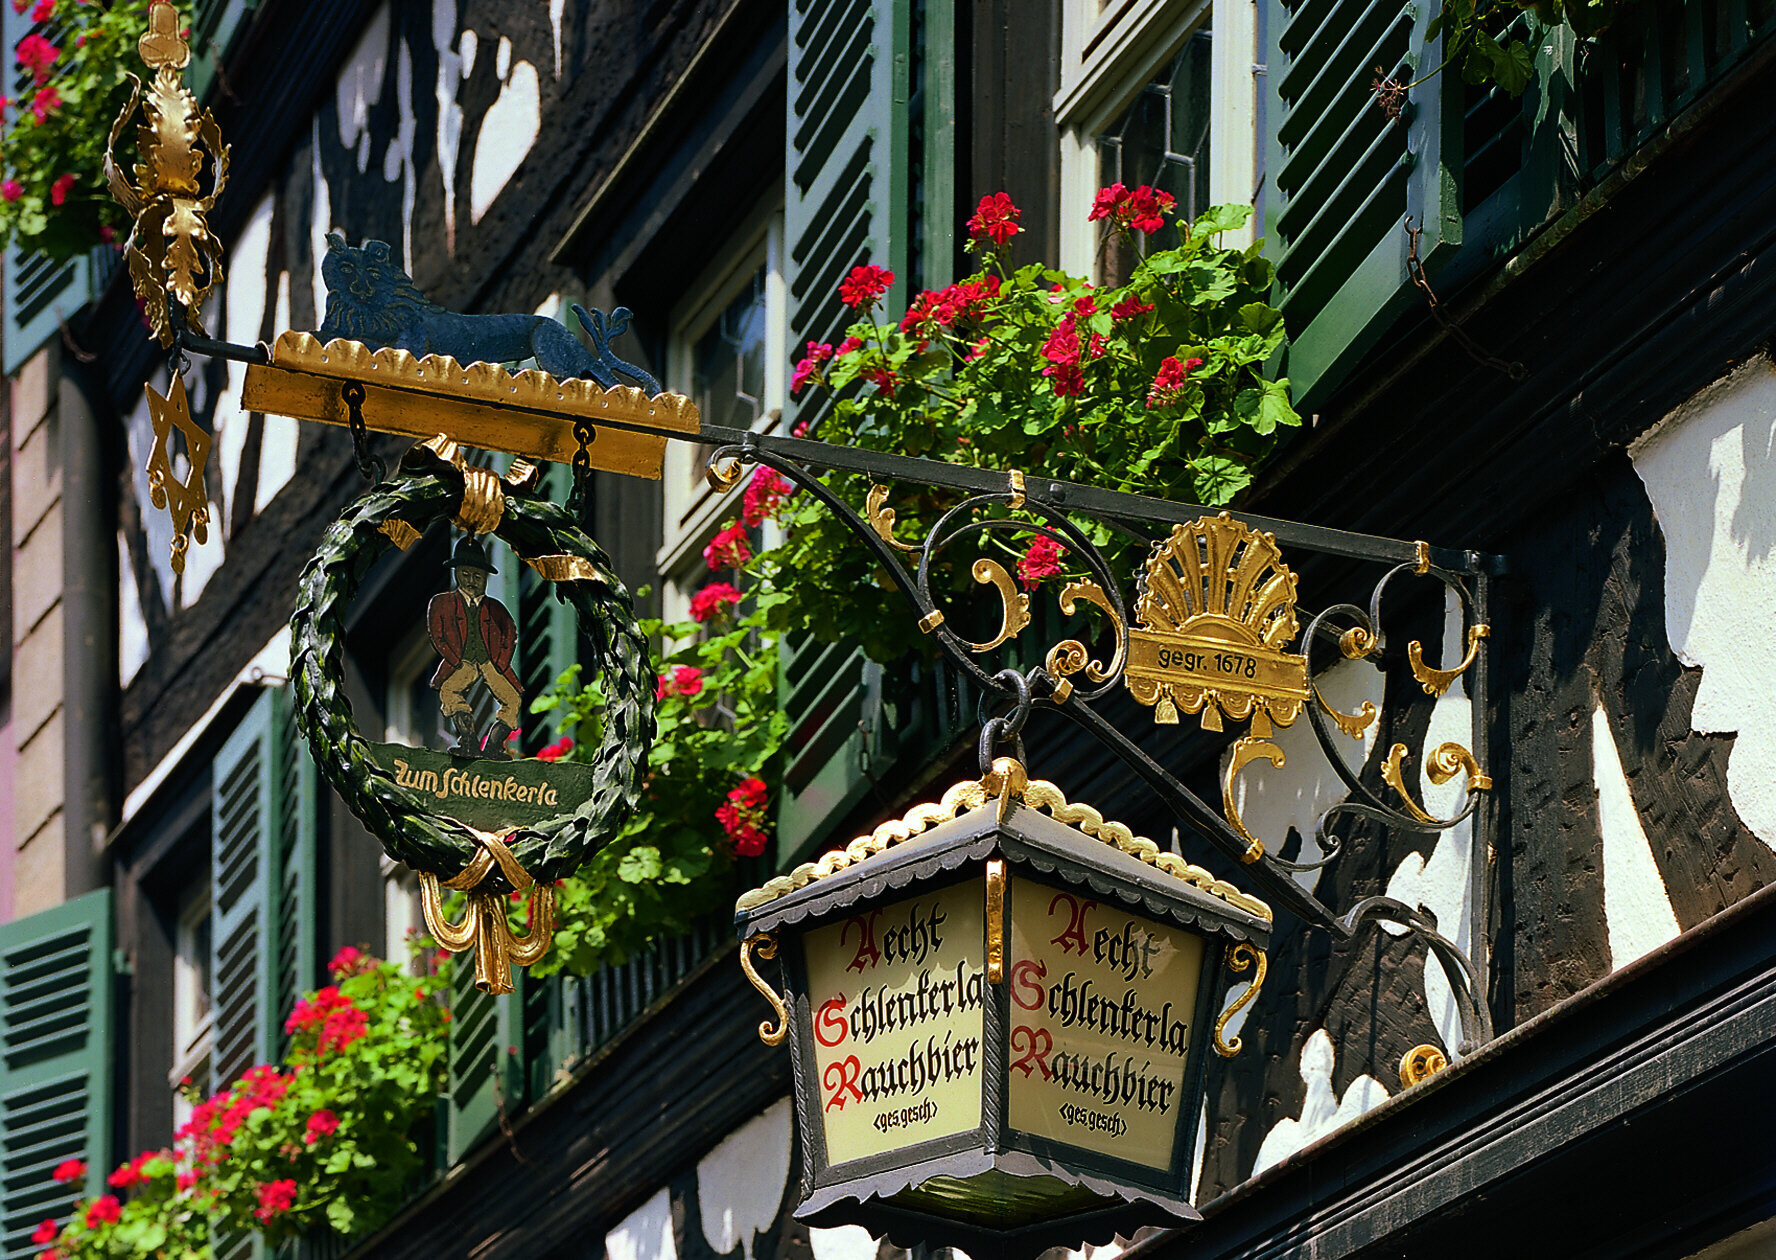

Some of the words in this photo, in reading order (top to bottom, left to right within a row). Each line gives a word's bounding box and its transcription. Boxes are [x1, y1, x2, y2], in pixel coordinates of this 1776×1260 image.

[1157, 649, 1208, 672] gegr.
[1213, 653, 1257, 679] 1678
[393, 759, 438, 793] Zum
[435, 767, 558, 806] Schlenkerla
[840, 902, 947, 975] Aecht
[1048, 892, 1161, 982] Aecht
[814, 960, 983, 1048] Schlenkerla
[1010, 958, 1188, 1057] Schlenkerla
[823, 1029, 980, 1113] Rauchbier
[1009, 1024, 1175, 1115] Rauchbier
